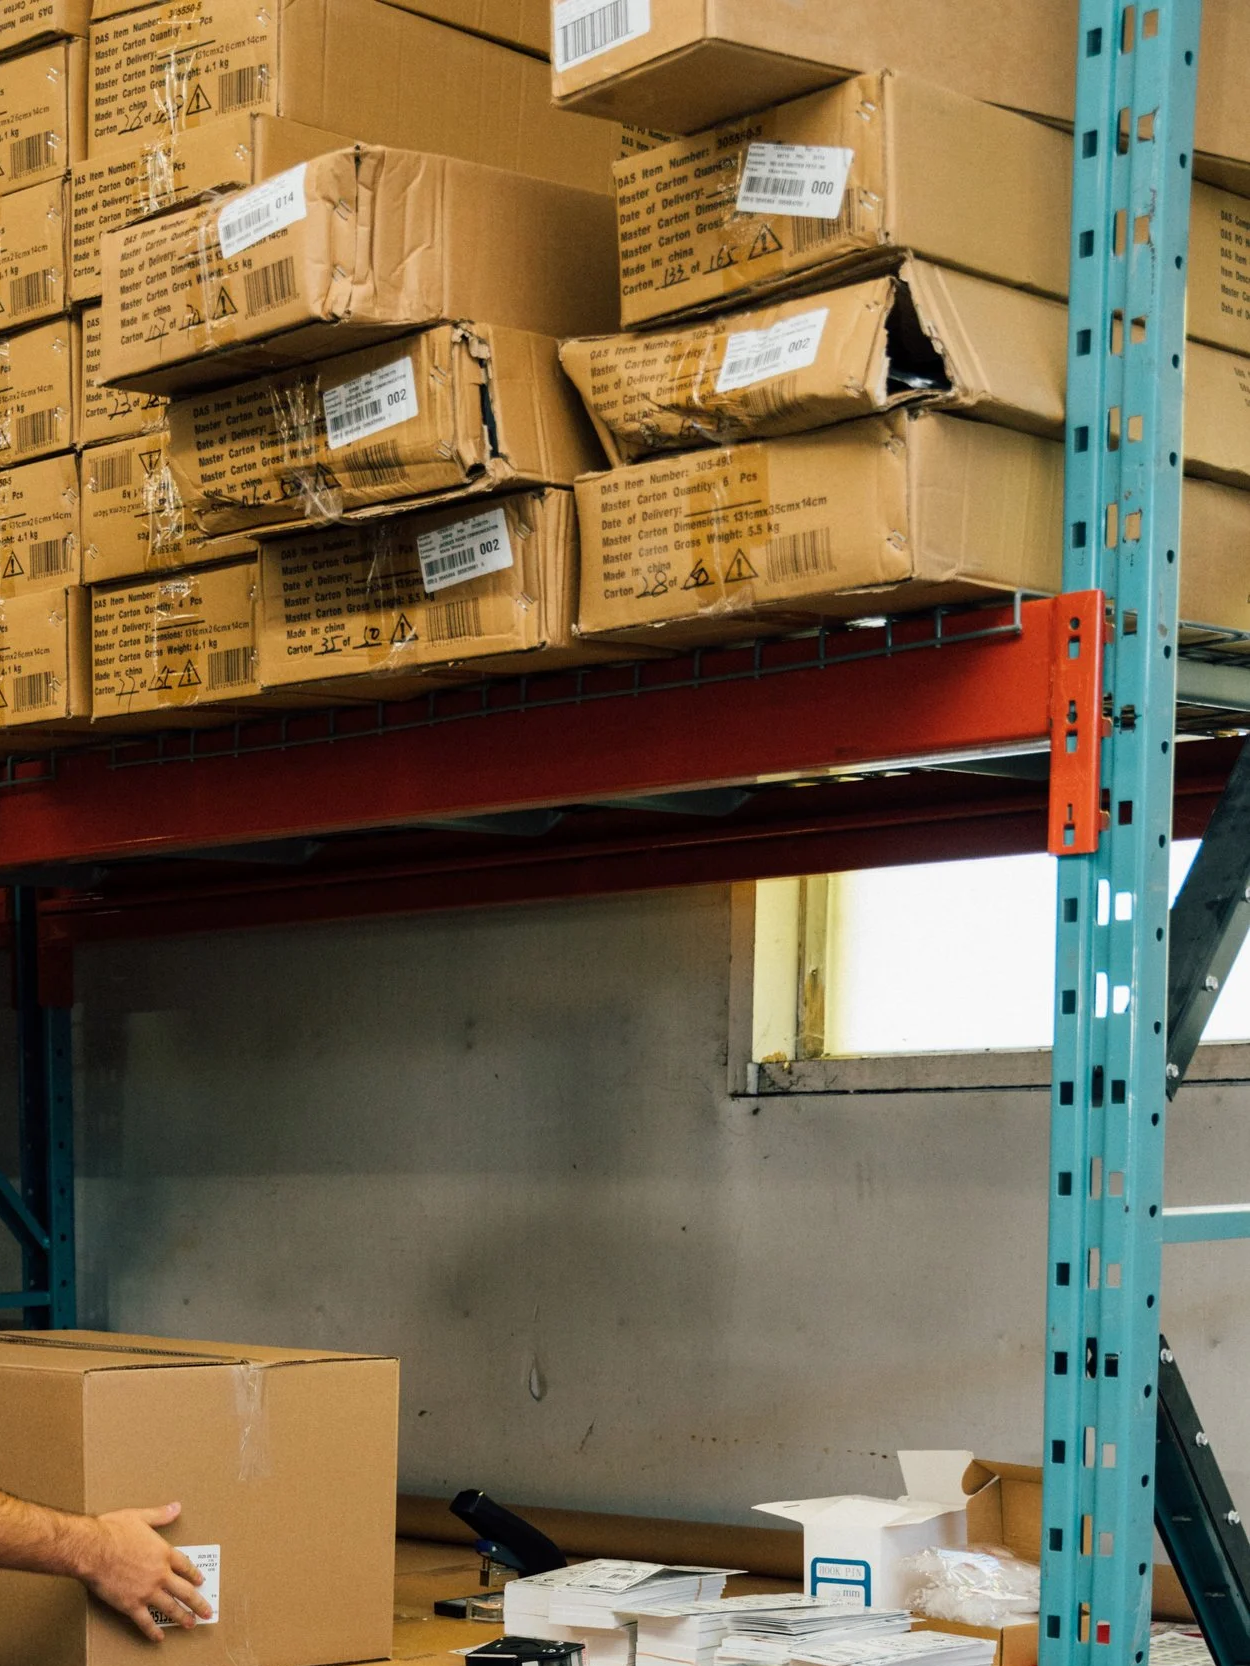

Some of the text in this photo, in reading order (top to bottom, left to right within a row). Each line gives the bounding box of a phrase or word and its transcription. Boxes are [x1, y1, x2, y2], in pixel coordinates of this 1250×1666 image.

[122, 38, 146, 51] Carton
[122, 70, 146, 83] Carton
[122, 85, 146, 98] Carton
[94, 125, 117, 138] Carton
[618, 148, 710, 189] DAS Item Number:
[619, 174, 688, 207] Master Carton
[811, 180, 834, 195] 000
[275, 191, 294, 209] 014
[620, 187, 705, 225] Date of Delivery:
[620, 211, 689, 243] Master Carton
[621, 229, 690, 261] Master Carton
[622, 264, 645, 279] Made
[668, 247, 694, 263] china
[622, 279, 653, 296] Carton
[120, 332, 144, 345] Carton
[788, 338, 810, 353] 002
[387, 388, 407, 406] 002
[600, 483, 619, 495] DAS
[624, 478, 644, 490] Item
[650, 470, 689, 485] Number:
[601, 500, 630, 513] Master
[637, 493, 667, 505] Carton
[673, 482, 716, 498] Quantity:
[740, 472, 758, 483] Pcs
[601, 507, 682, 531] Date of Delivery:
[601, 527, 668, 548] Master Carton
[602, 522, 780, 565] Master Carton Gross 5.5 kg
[479, 539, 500, 556] 002
[603, 561, 671, 581] Made in: china
[604, 586, 634, 599] Carton
[119, 608, 140, 618] Carton
[286, 622, 345, 640] Made china
[119, 638, 141, 648] Carton
[287, 643, 312, 655] Carton
[119, 653, 141, 663] Carton
[95, 686, 115, 696] Carton
[819, 1566, 862, 1577] HOOK PIN
